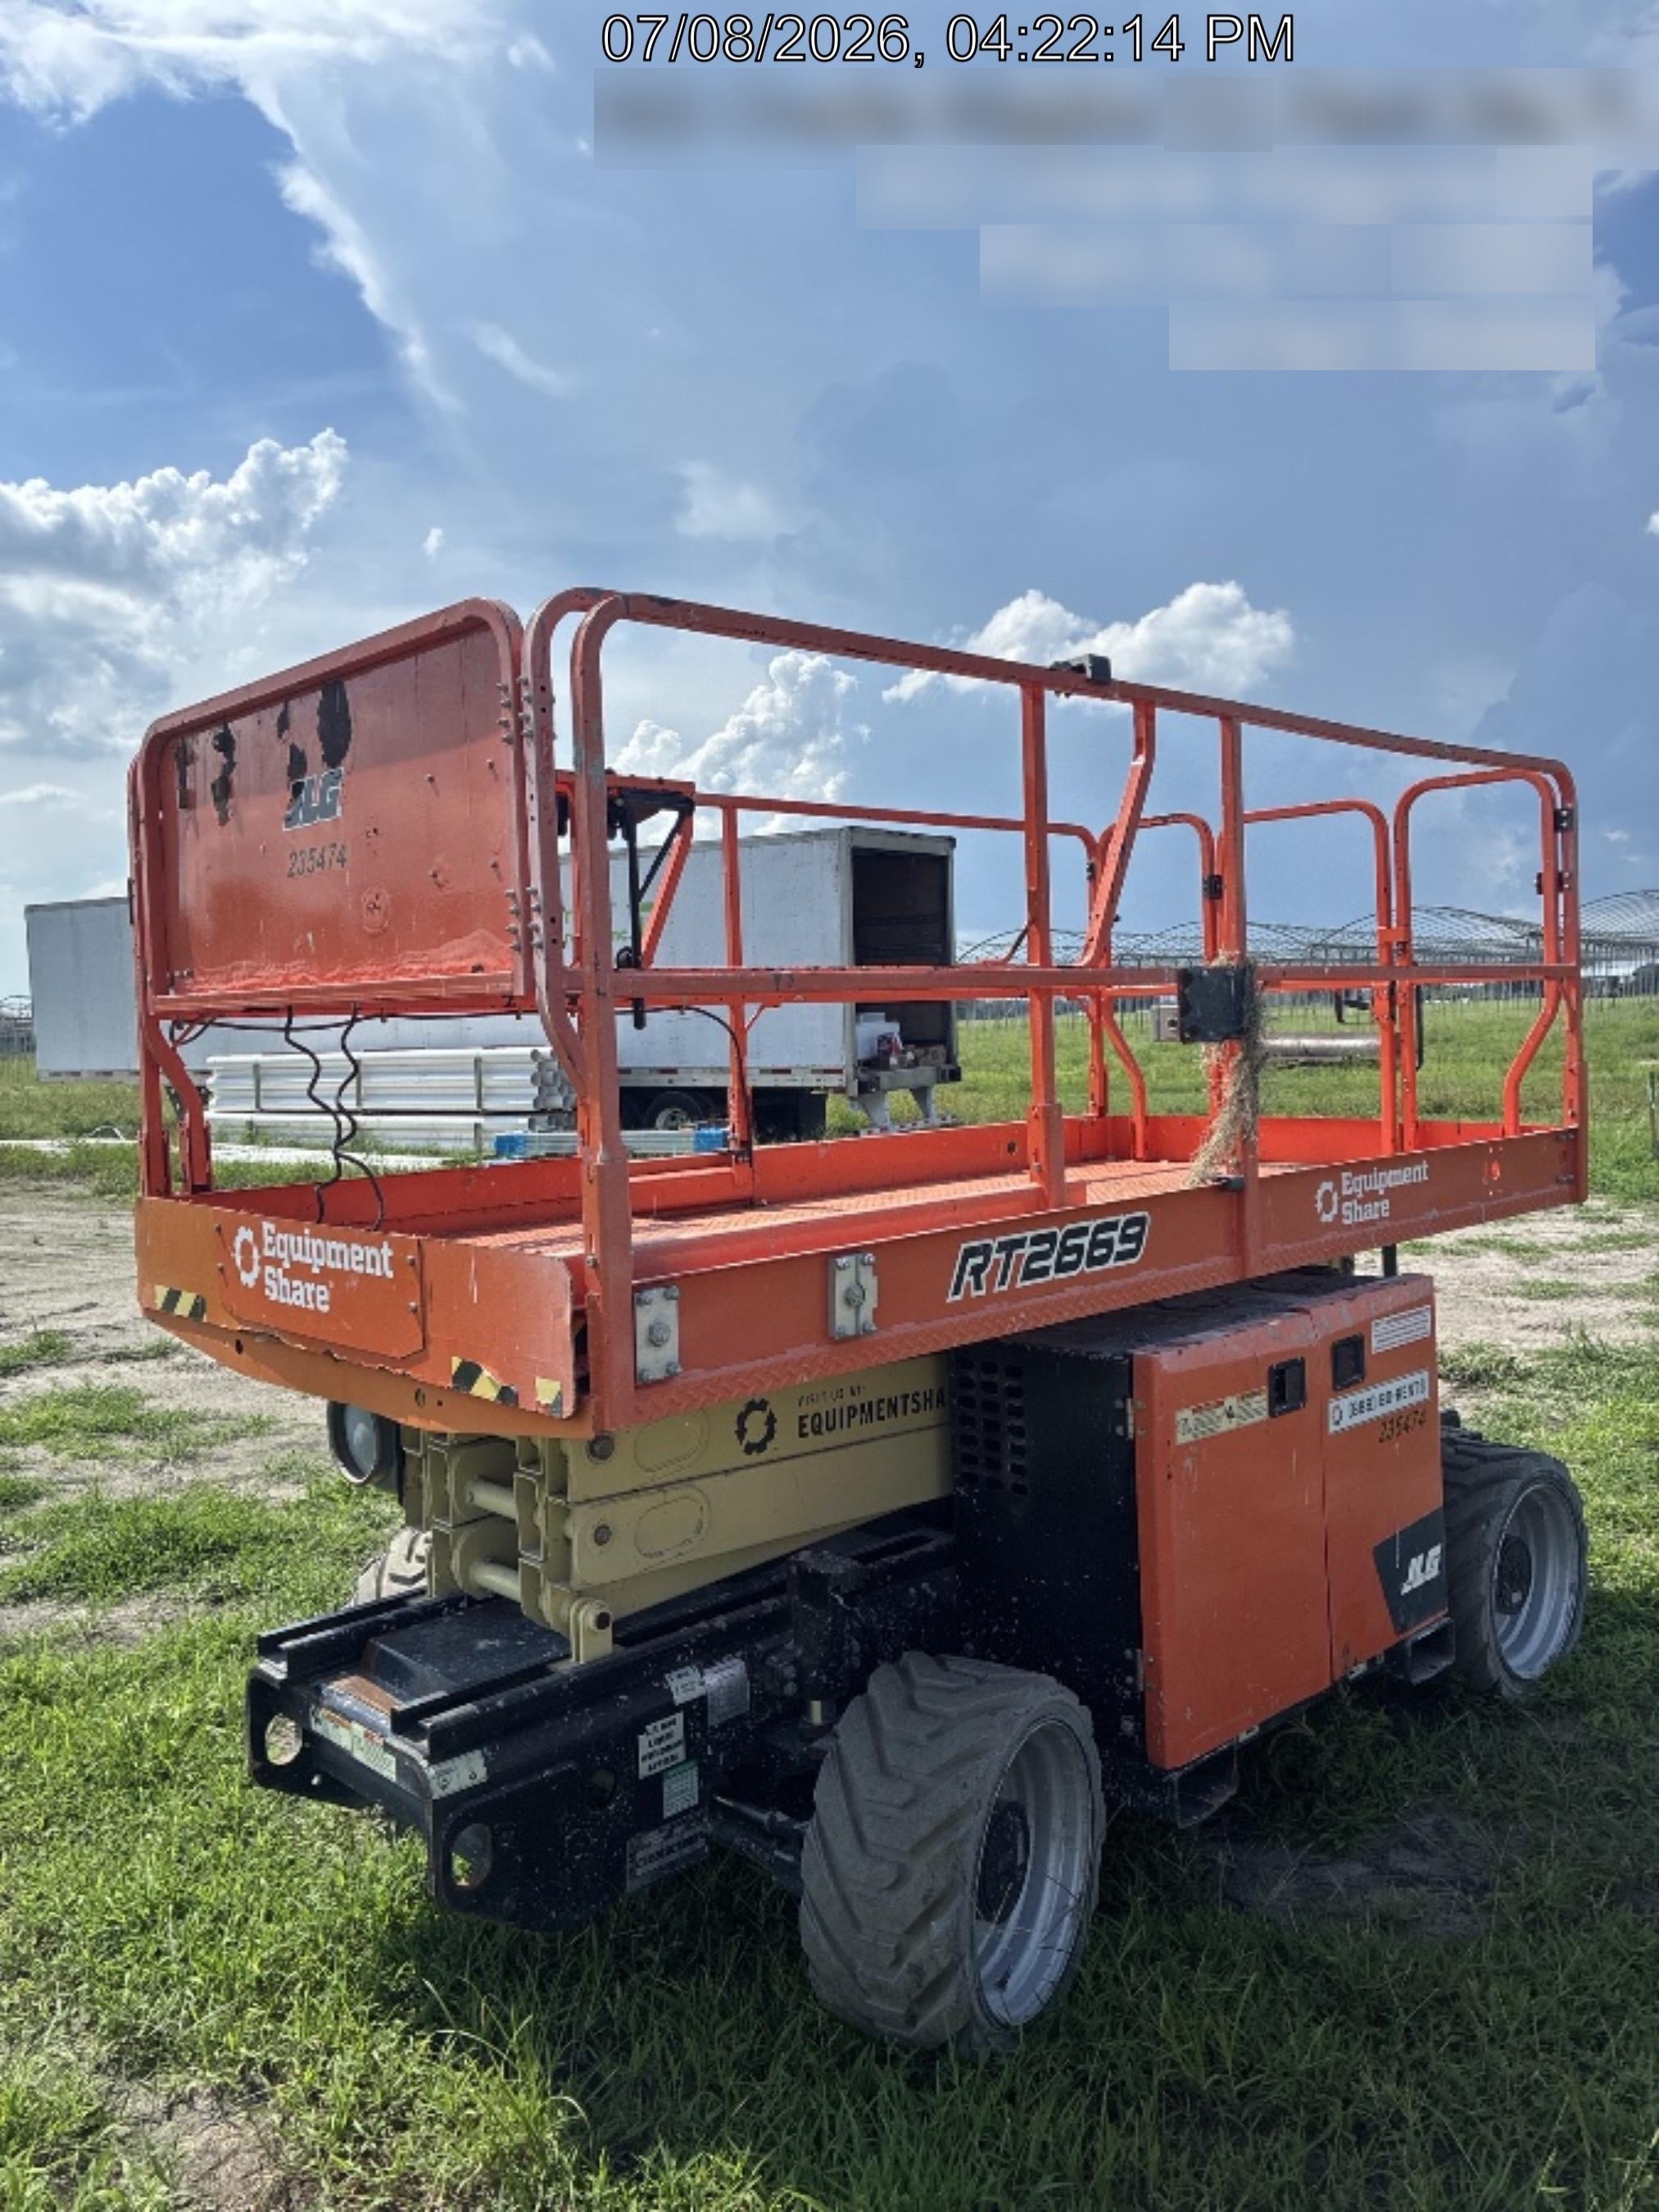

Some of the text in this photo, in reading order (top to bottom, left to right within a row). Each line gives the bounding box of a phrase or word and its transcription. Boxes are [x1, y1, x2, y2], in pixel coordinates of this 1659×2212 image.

[283, 767, 344, 832] JLG
[287, 842, 347, 878] 235474
[1341, 1160, 1430, 1196] Equipment
[1341, 1199, 1391, 1226] Share
[261, 1222, 395, 1279] Equipment
[947, 1211, 1150, 1303] RT2669
[264, 1265, 331, 1314] Share
[1379, 1408, 1428, 1444] 235474
[1400, 1543, 1443, 1596] JLG
